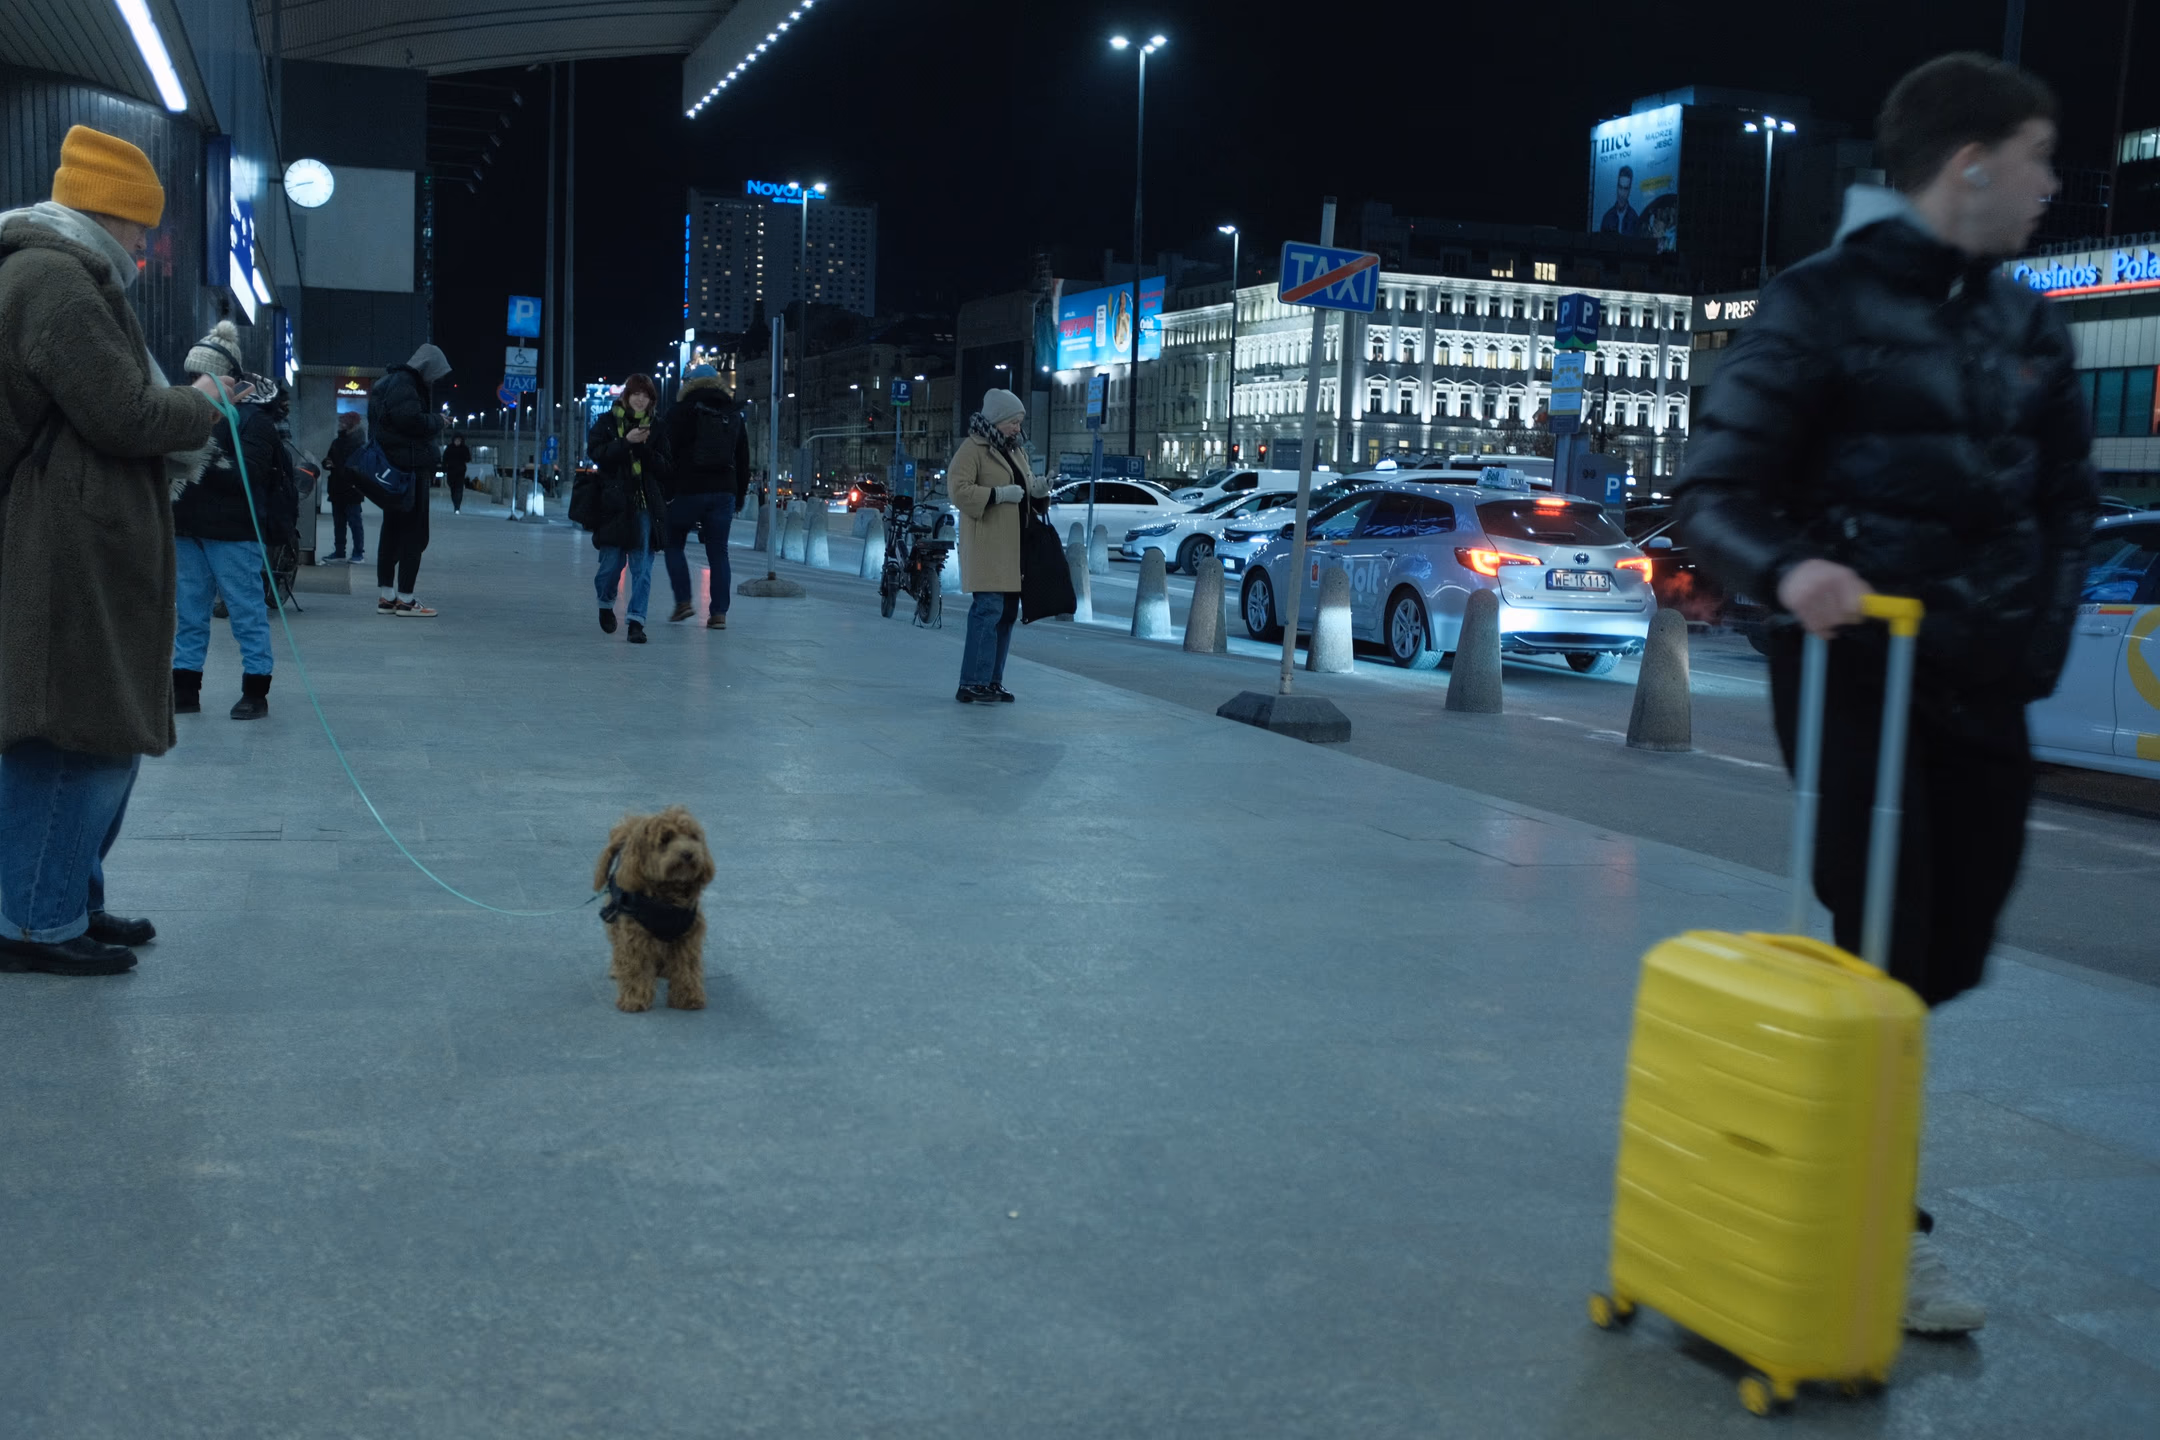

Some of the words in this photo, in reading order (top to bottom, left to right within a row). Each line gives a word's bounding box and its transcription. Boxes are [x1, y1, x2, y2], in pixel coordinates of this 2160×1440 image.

[1601, 131, 1632, 153] nice
[1619, 150, 1632, 160] YOU
[1290, 251, 1372, 305] TAXI
[2014, 260, 2098, 291] Casinos
[515, 299, 534, 324] P
[1561, 301, 1570, 324] P
[1582, 301, 1593, 324] P
[1724, 299, 1759, 320] PRES
[506, 376, 534, 390] TAXI
[900, 383, 907, 394] P
[1510, 478, 1525, 486] TAXI
[1607, 477, 1620, 496] P
[1555, 573, 1570, 586] WE
[1575, 574, 1607, 588] 1K113
